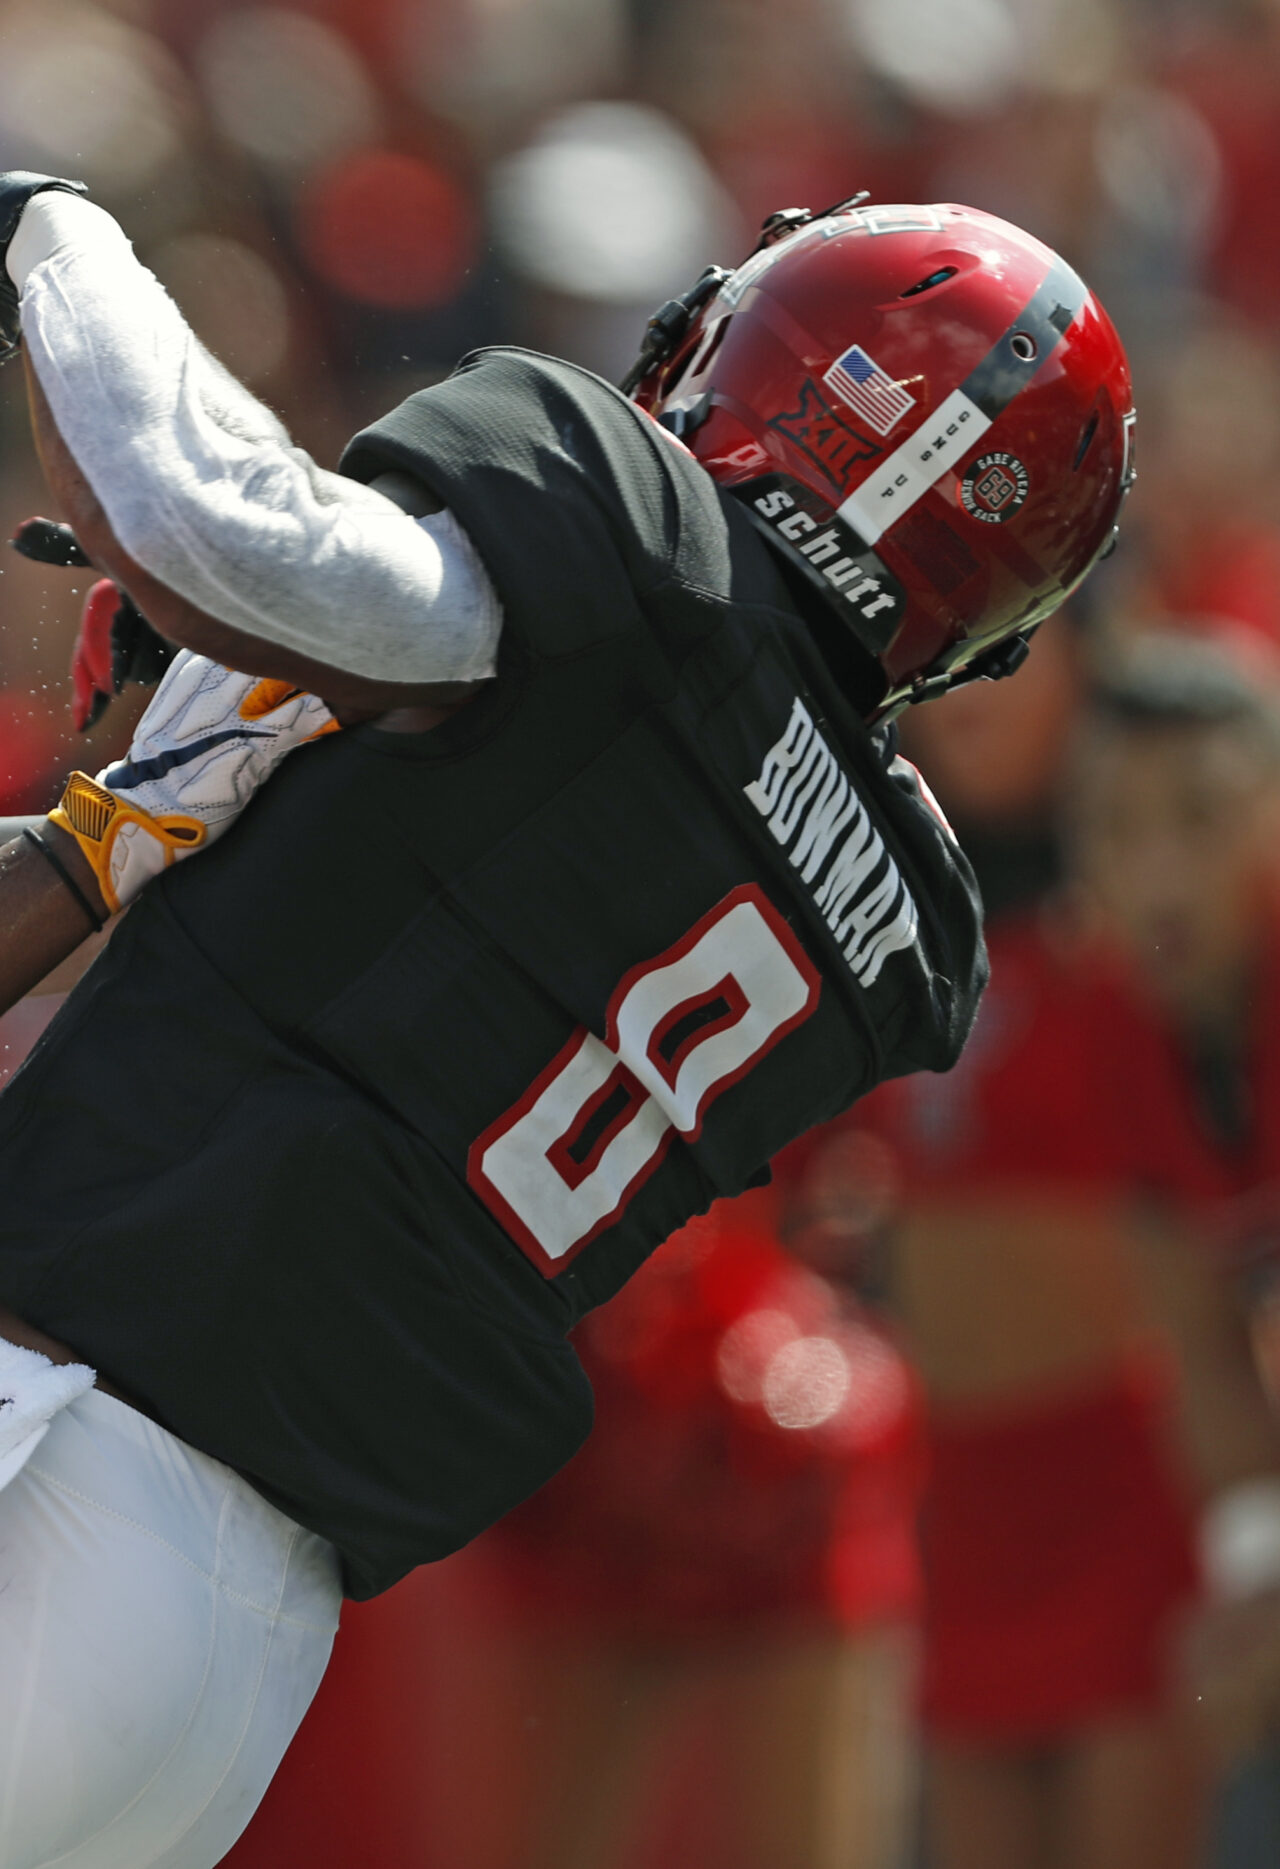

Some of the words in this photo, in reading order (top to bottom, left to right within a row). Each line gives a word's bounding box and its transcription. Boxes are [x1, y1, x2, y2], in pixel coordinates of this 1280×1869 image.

[920, 411, 971, 462] GUNS
[881, 473, 909, 498] UP
[976, 452, 1011, 470] GABE
[1008, 459, 1029, 505] RIVERA
[976, 467, 1016, 510] 69
[972, 508, 1002, 523] SACK
[754, 490, 896, 619] schutt
[742, 696, 920, 988] BOWMAN
